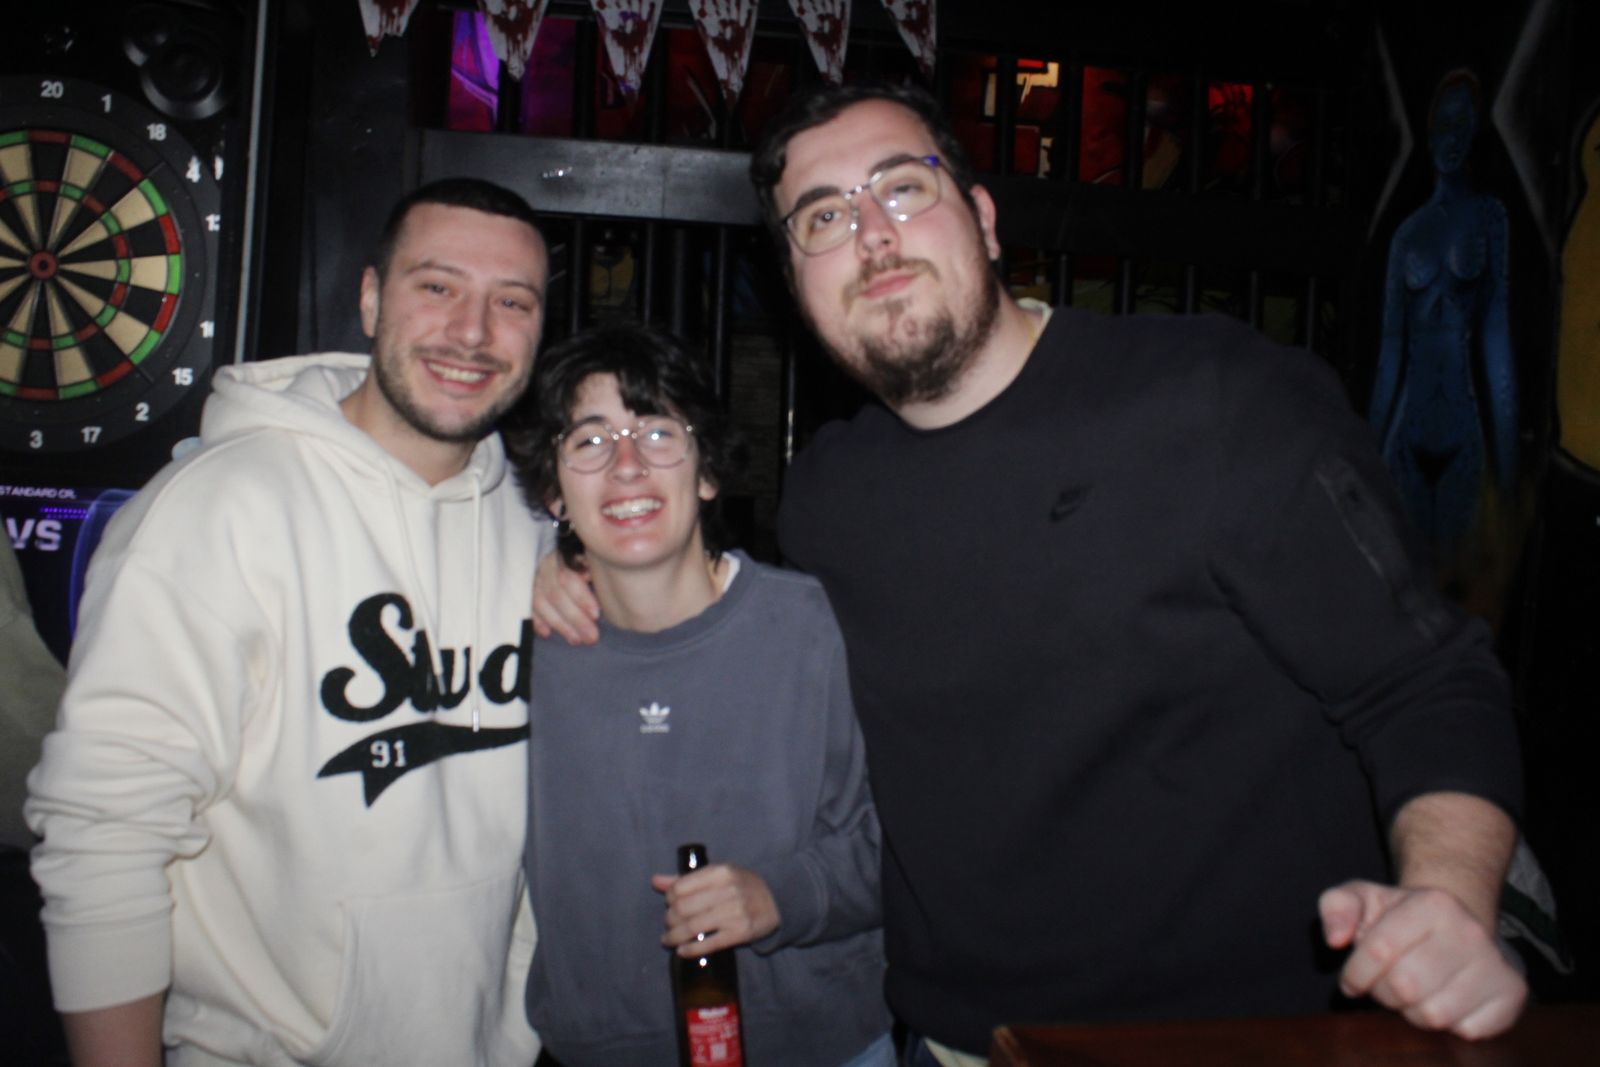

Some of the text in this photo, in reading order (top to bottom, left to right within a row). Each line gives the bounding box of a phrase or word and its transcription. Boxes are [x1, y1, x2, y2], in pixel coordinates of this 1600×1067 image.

[41, 80, 64, 99] 20
[101, 94, 112, 113] 1
[147, 123, 167, 141] 18
[186, 156, 201, 183] 4
[172, 368, 193, 386] 15
[135, 402, 150, 421] 2
[30, 430, 43, 448] 3
[81, 426, 101, 444] 17
[6, 517, 62, 551] VS
[371, 740, 407, 768] 91
